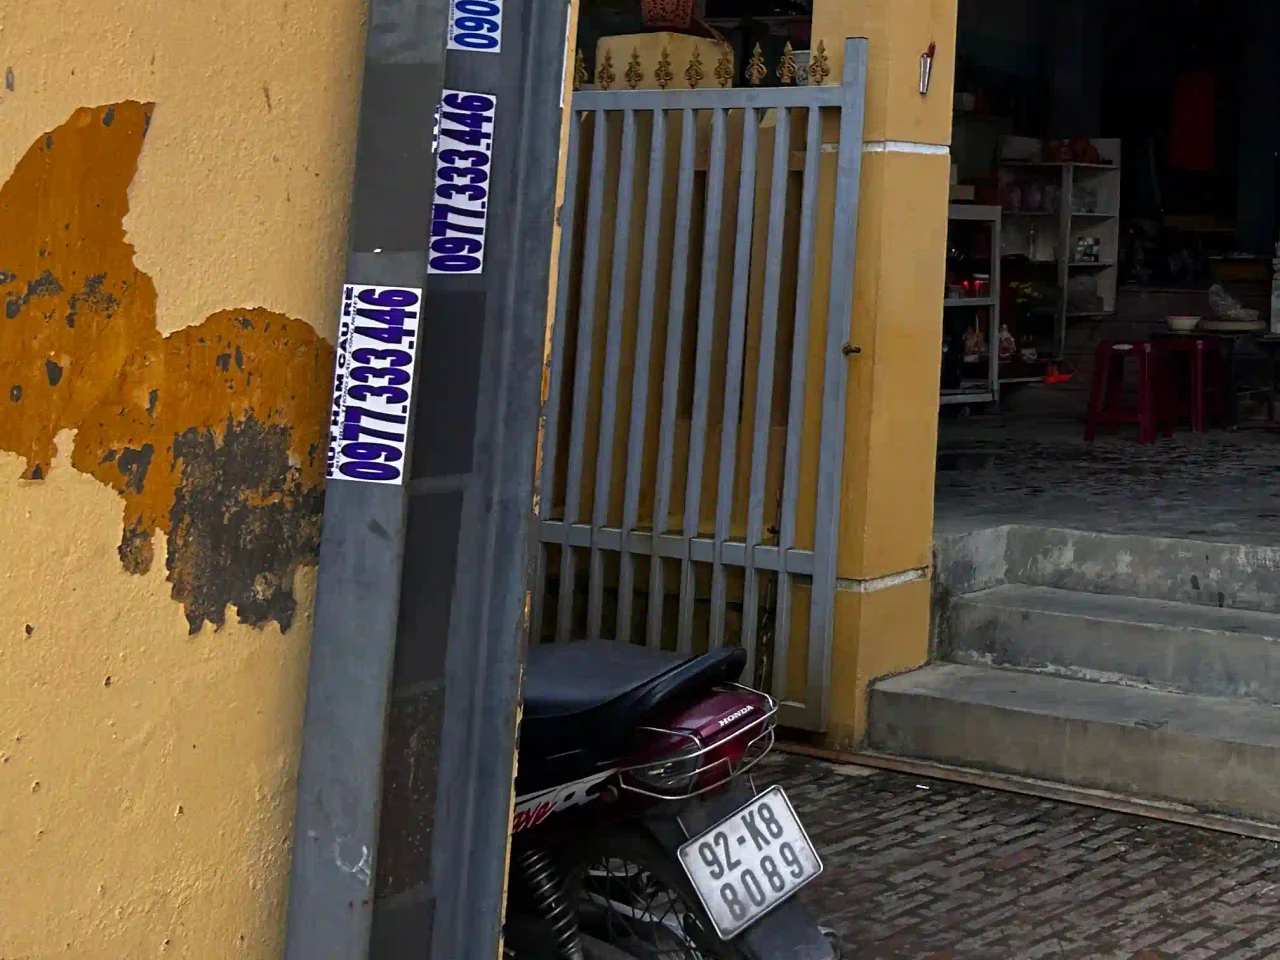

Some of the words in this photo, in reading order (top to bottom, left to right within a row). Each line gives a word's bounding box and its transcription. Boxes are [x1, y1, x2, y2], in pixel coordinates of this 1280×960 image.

[429, 92, 494, 273] 0977.333.446
[338, 287, 419, 481] 0977.333.446
[718, 704, 755, 727] HONDA
[698, 802, 783, 880] 92-K8
[719, 841, 804, 922] 8089
